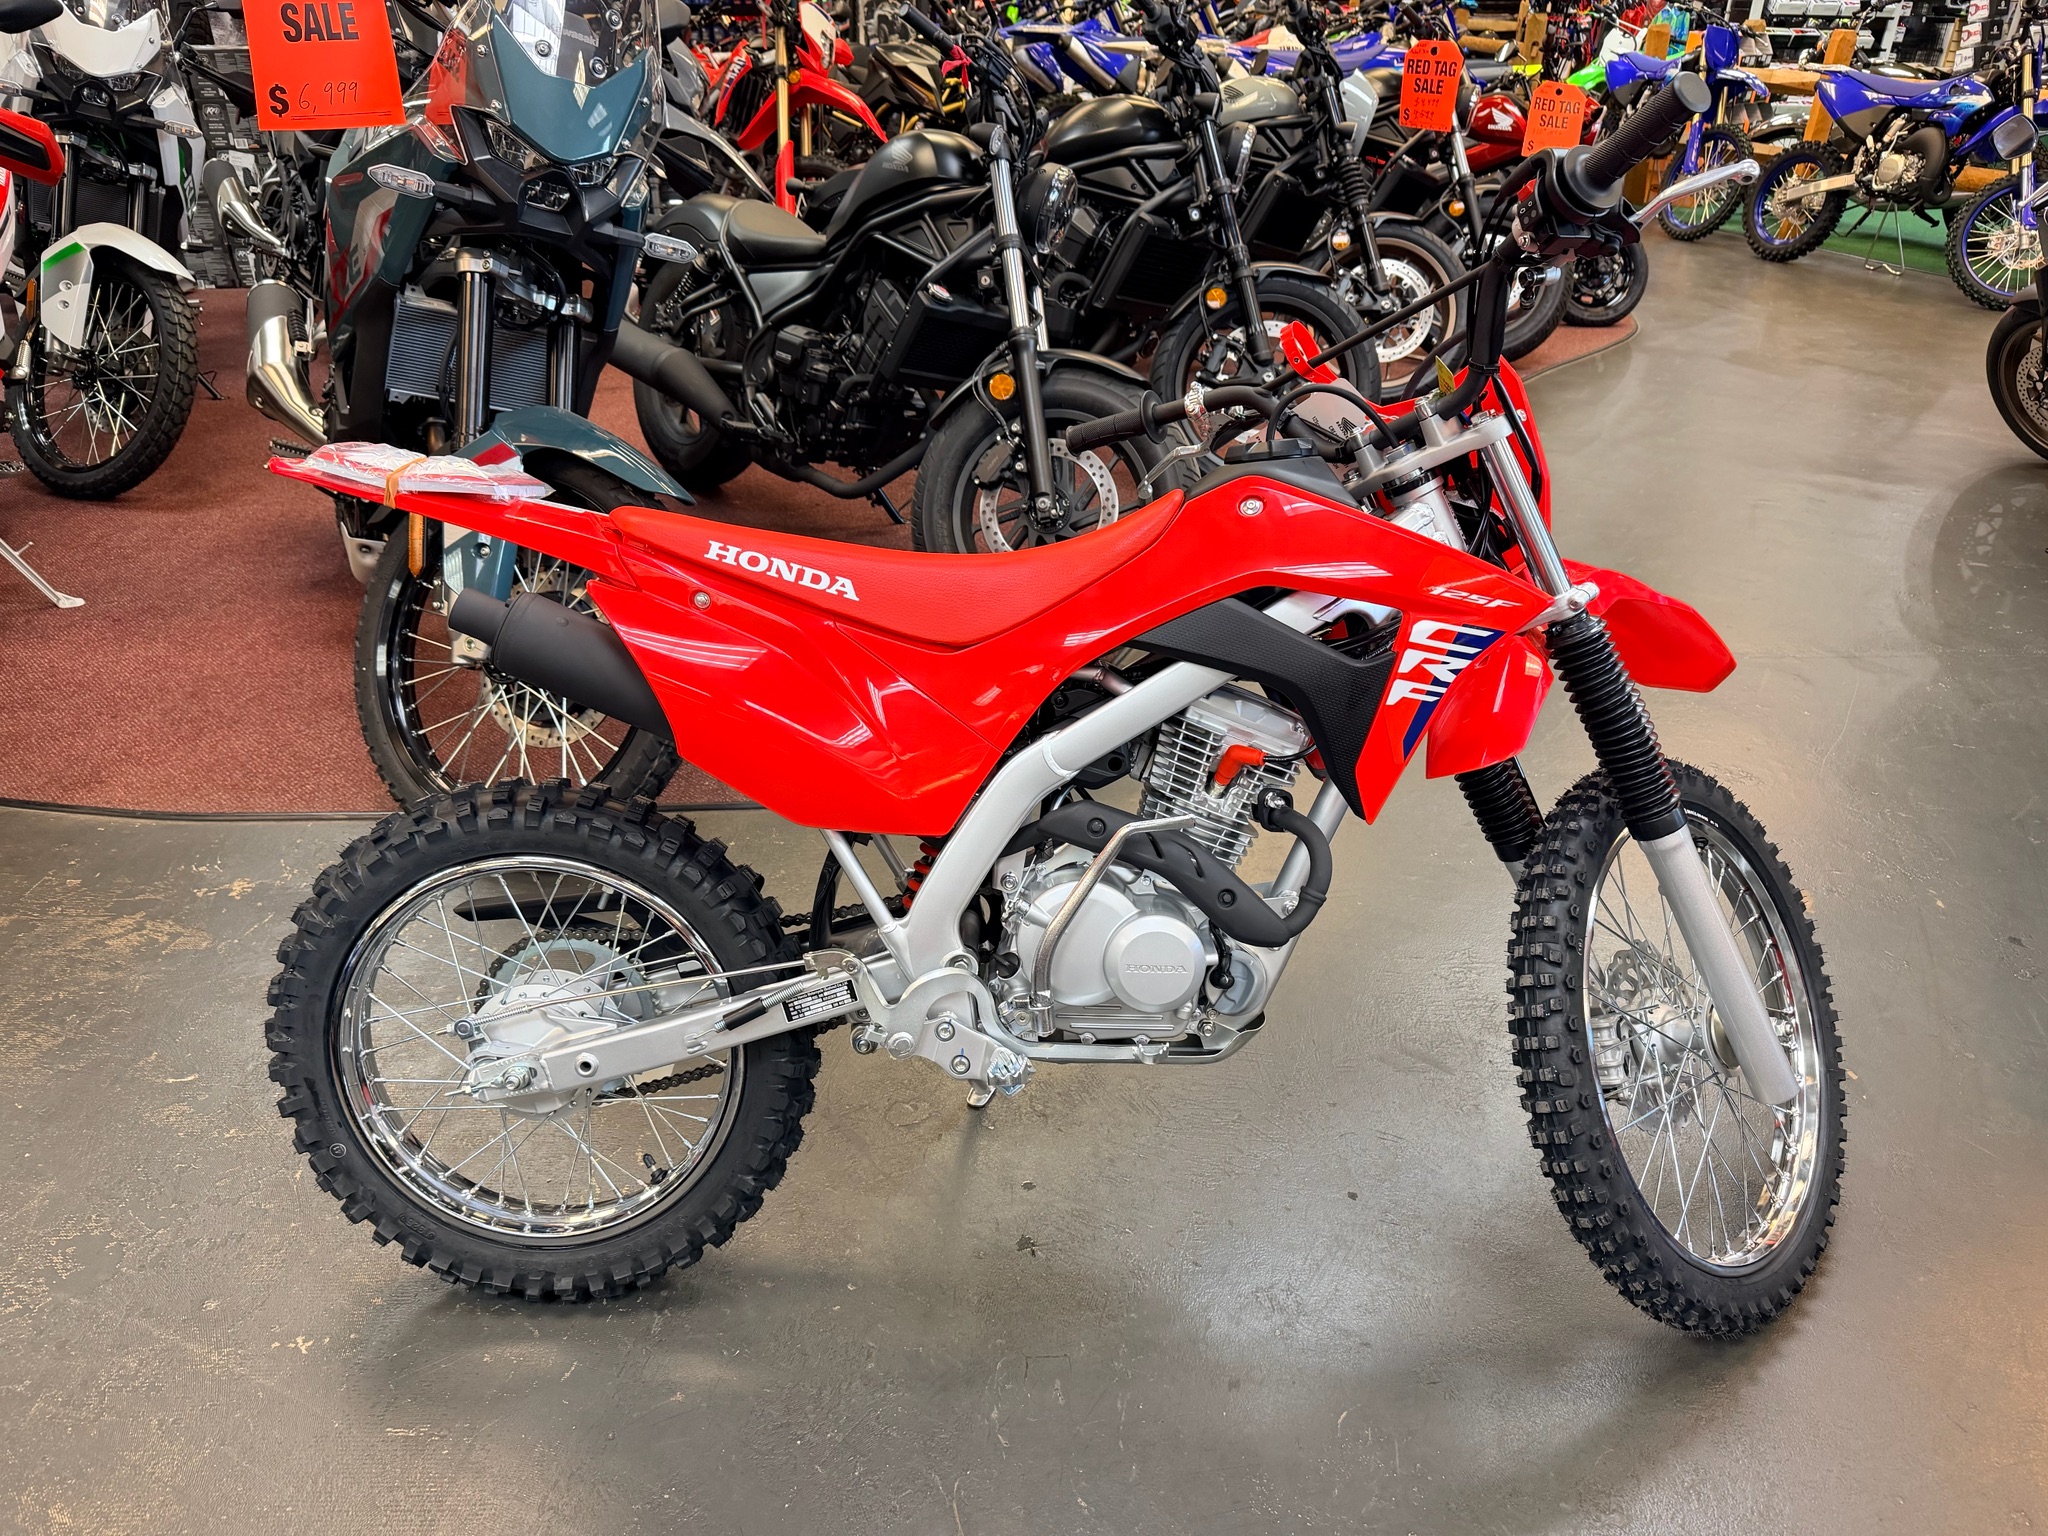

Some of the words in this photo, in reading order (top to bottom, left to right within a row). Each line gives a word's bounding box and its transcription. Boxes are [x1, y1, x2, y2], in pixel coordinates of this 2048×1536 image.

[280, 2, 360, 43] SALE
[1406, 58, 1431, 75] RED
[1434, 60, 1458, 77] TAG
[1413, 77, 1445, 95] SALE
[269, 83, 290, 118] $
[298, 81, 358, 114] 6,999
[1533, 96, 1556, 112] RED
[1559, 100, 1581, 114] TAG
[1403, 107, 1411, 121] $
[1539, 113, 1569, 129] SALE
[1527, 139, 1535, 152] $
[704, 540, 860, 601] HONDA
[1427, 585, 1523, 608] 125F
[1384, 619, 1495, 706] CRF
[1125, 964, 1189, 974] HONDA
